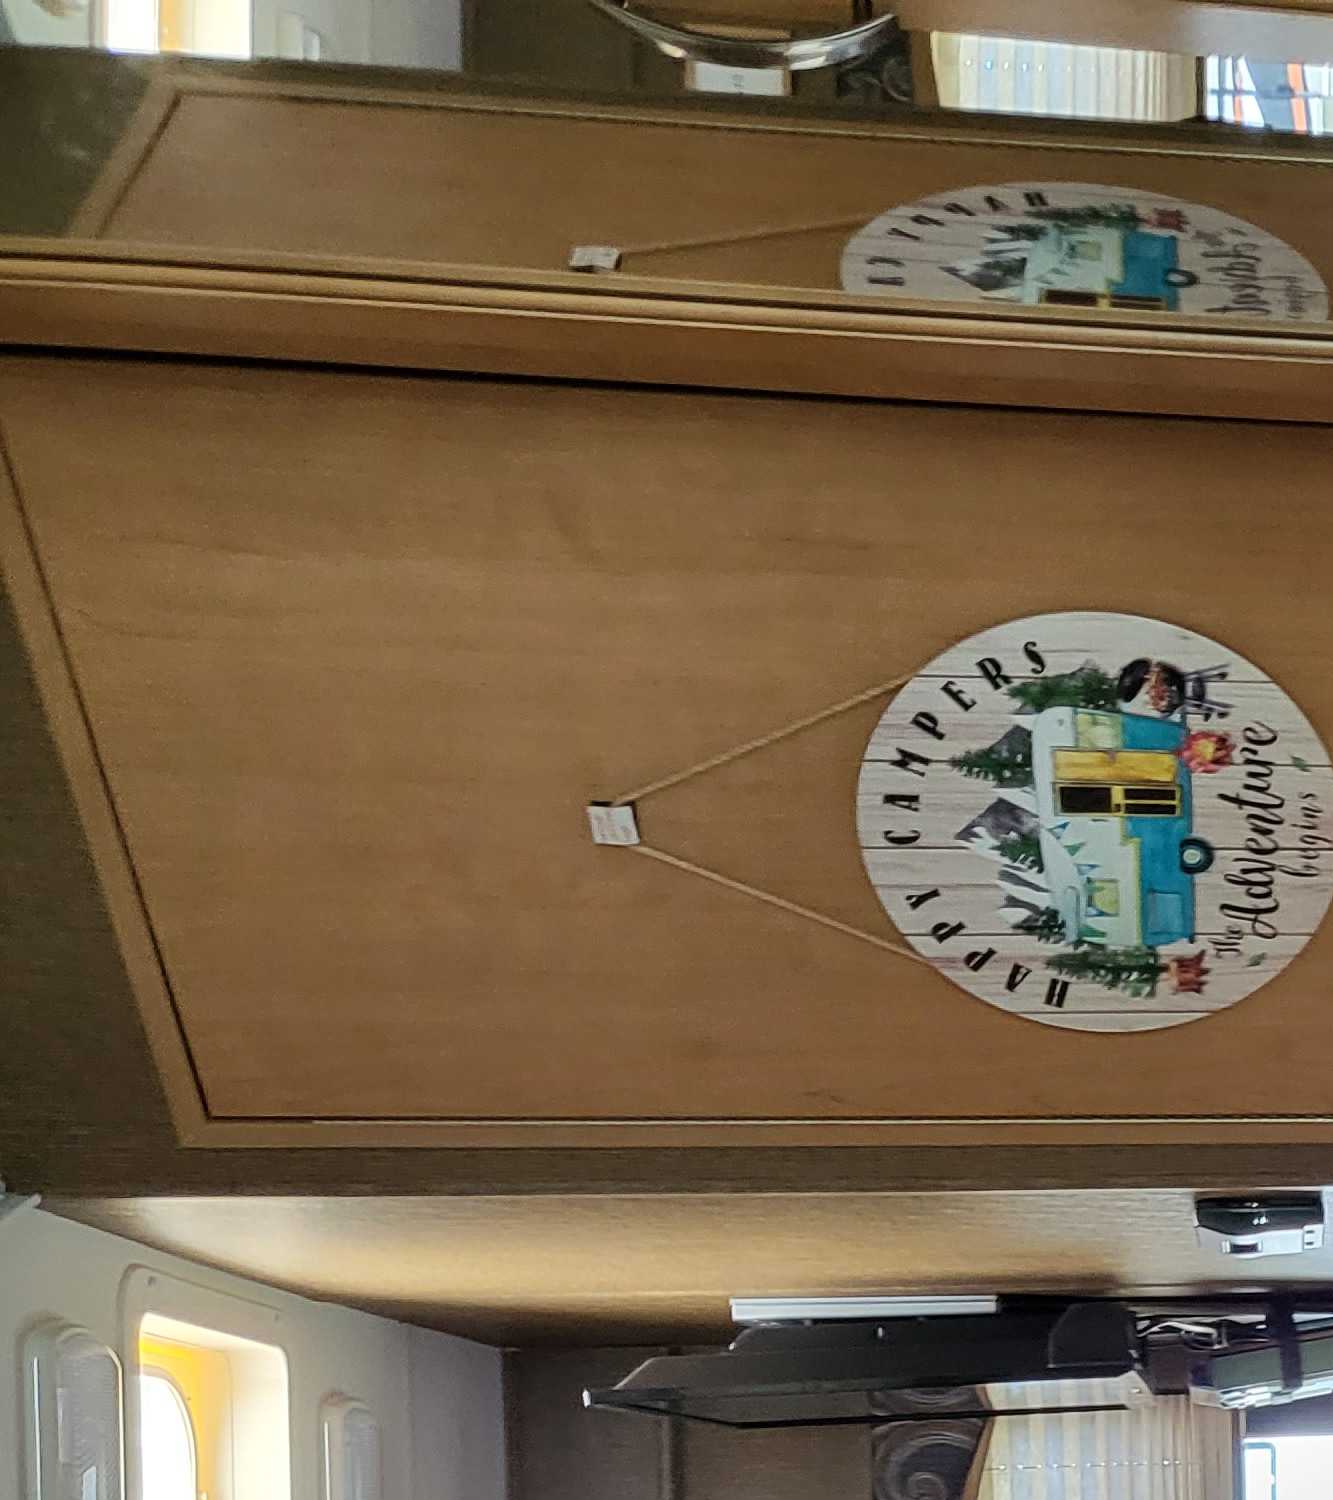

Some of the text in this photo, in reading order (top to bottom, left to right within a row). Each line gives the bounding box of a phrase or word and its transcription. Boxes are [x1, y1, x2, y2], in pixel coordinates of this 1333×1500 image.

[882, 641, 1071, 1009] HAPPY CAMPERS
[1217, 720, 1284, 940] Adventure
[1279, 791, 1333, 877] begins
[1213, 924, 1244, 959] The
